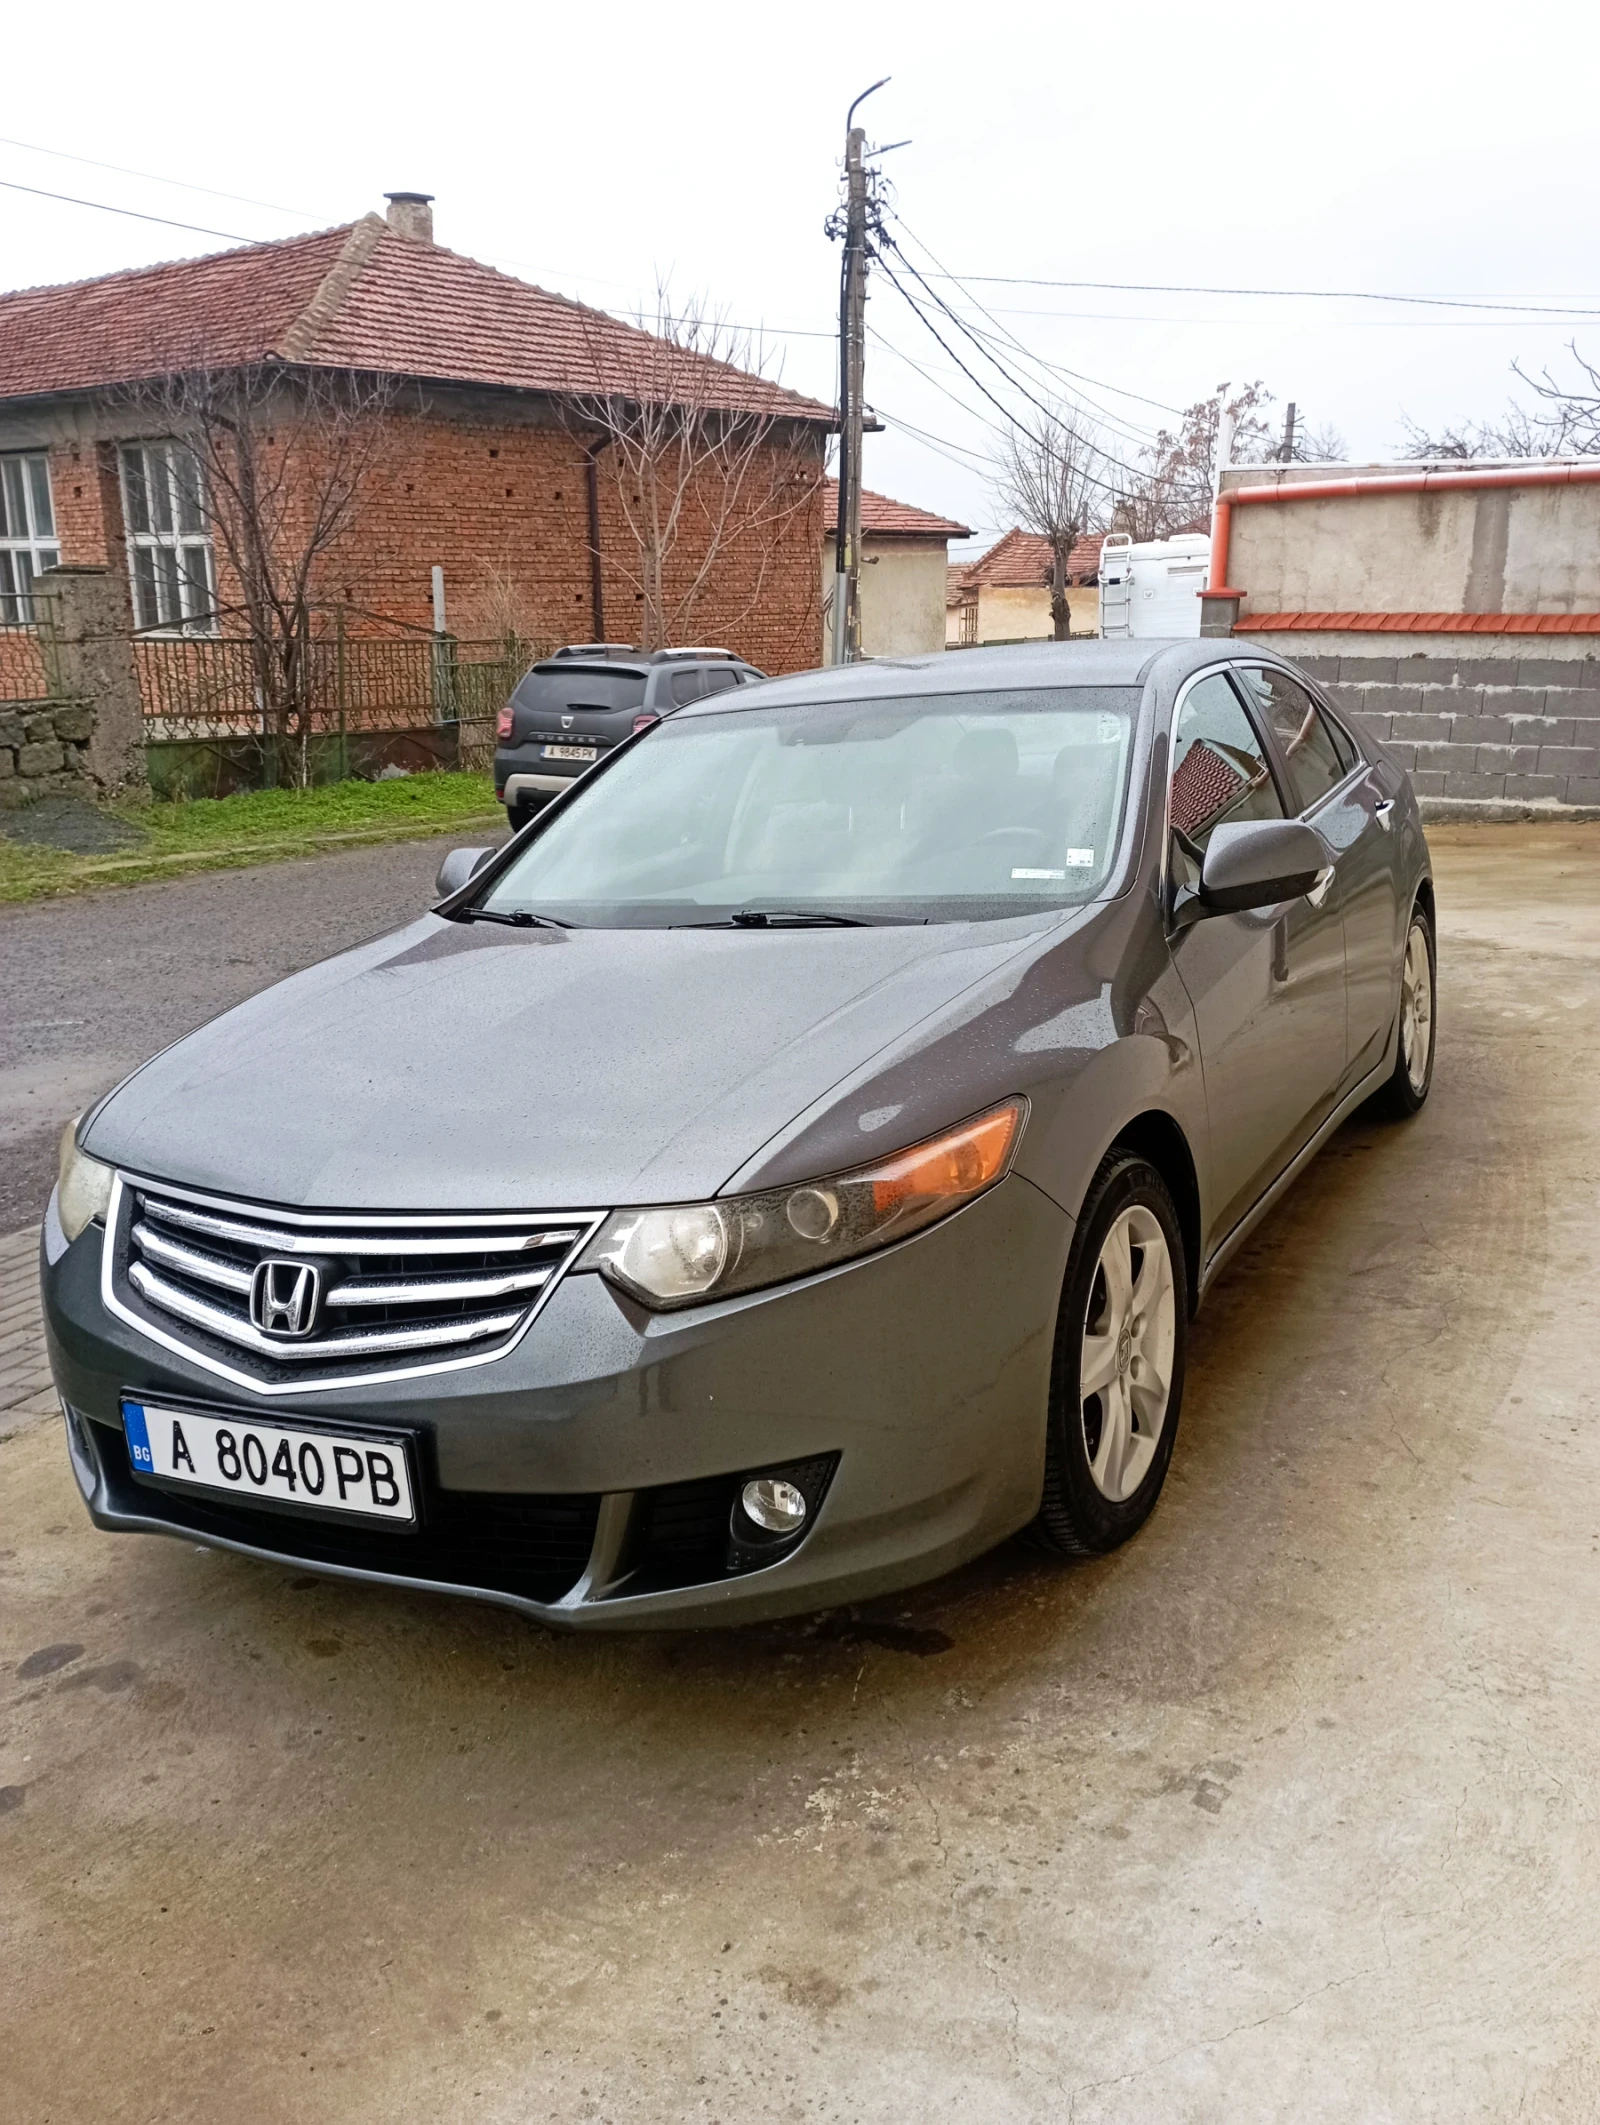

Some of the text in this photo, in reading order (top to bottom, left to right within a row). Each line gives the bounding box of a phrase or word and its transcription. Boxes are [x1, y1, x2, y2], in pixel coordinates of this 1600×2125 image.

[537, 734, 596, 743] DUSTER
[134, 1444, 150, 1462] BG
[172, 1420, 196, 1473] A
